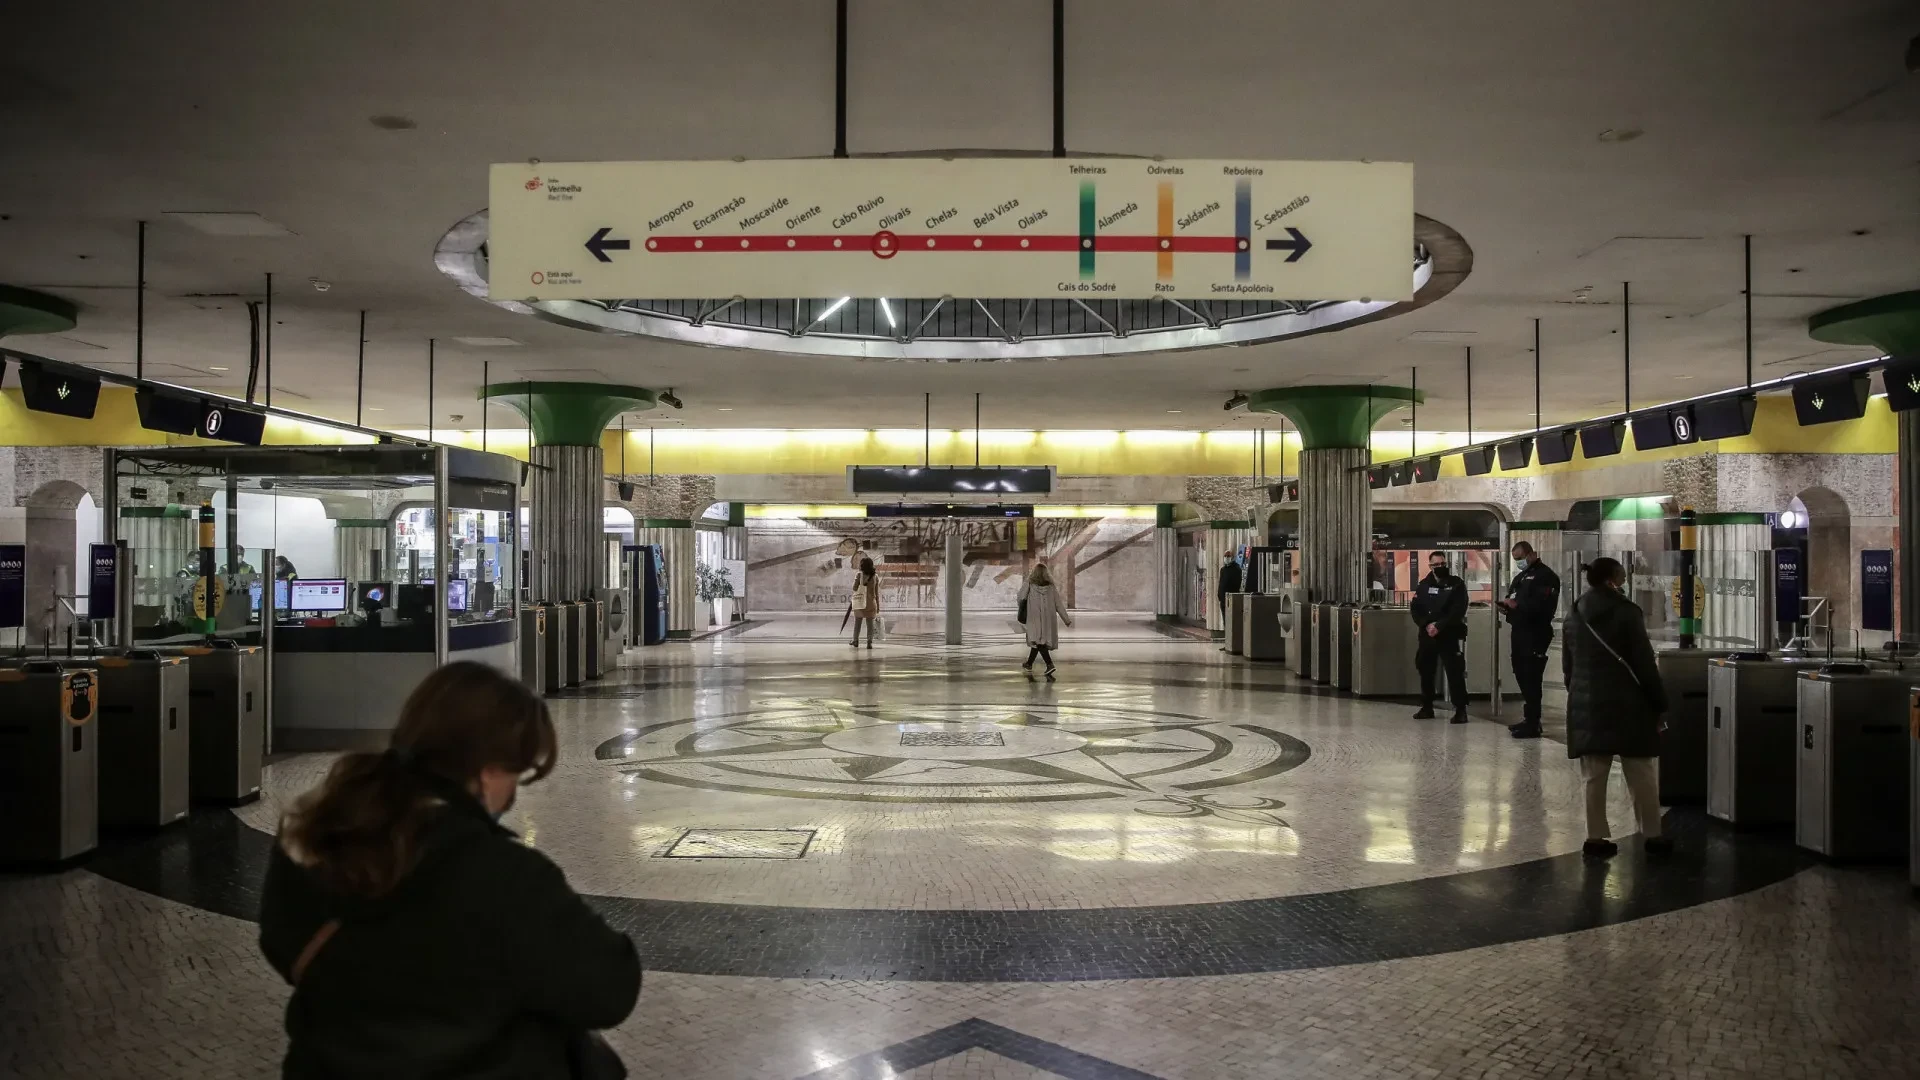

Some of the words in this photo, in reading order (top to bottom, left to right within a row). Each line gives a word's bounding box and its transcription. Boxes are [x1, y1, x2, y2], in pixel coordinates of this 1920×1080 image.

[1069, 164, 1107, 174] Telheiras
[1147, 165, 1184, 175] Odivelas
[1223, 166, 1263, 175] Reboleira
[648, 200, 694, 231] Aeroporto
[692, 196, 746, 231] Encarnação
[739, 197, 789, 230] Moscavide
[785, 204, 821, 229] Oriente
[832, 211, 858, 229] Cabo
[856, 195, 884, 216] Ruivo
[879, 206, 911, 229] Olivais
[925, 206, 958, 229] Chelas
[973, 211, 996, 229] Bela
[993, 198, 1019, 216] Vista
[1017, 208, 1048, 229] Olaias
[1098, 202, 1138, 229] Alameda
[1177, 200, 1220, 229] Saldanha
[1254, 219, 1265, 230] S.
[1263, 194, 1310, 225] Sebastião
[1057, 282, 1076, 292] Cais
[1078, 282, 1090, 292] do
[1091, 282, 1117, 292] Sodré
[1155, 283, 1175, 292] Rato
[1211, 283, 1235, 293] Santa
[1236, 283, 1274, 294] Apolónia
